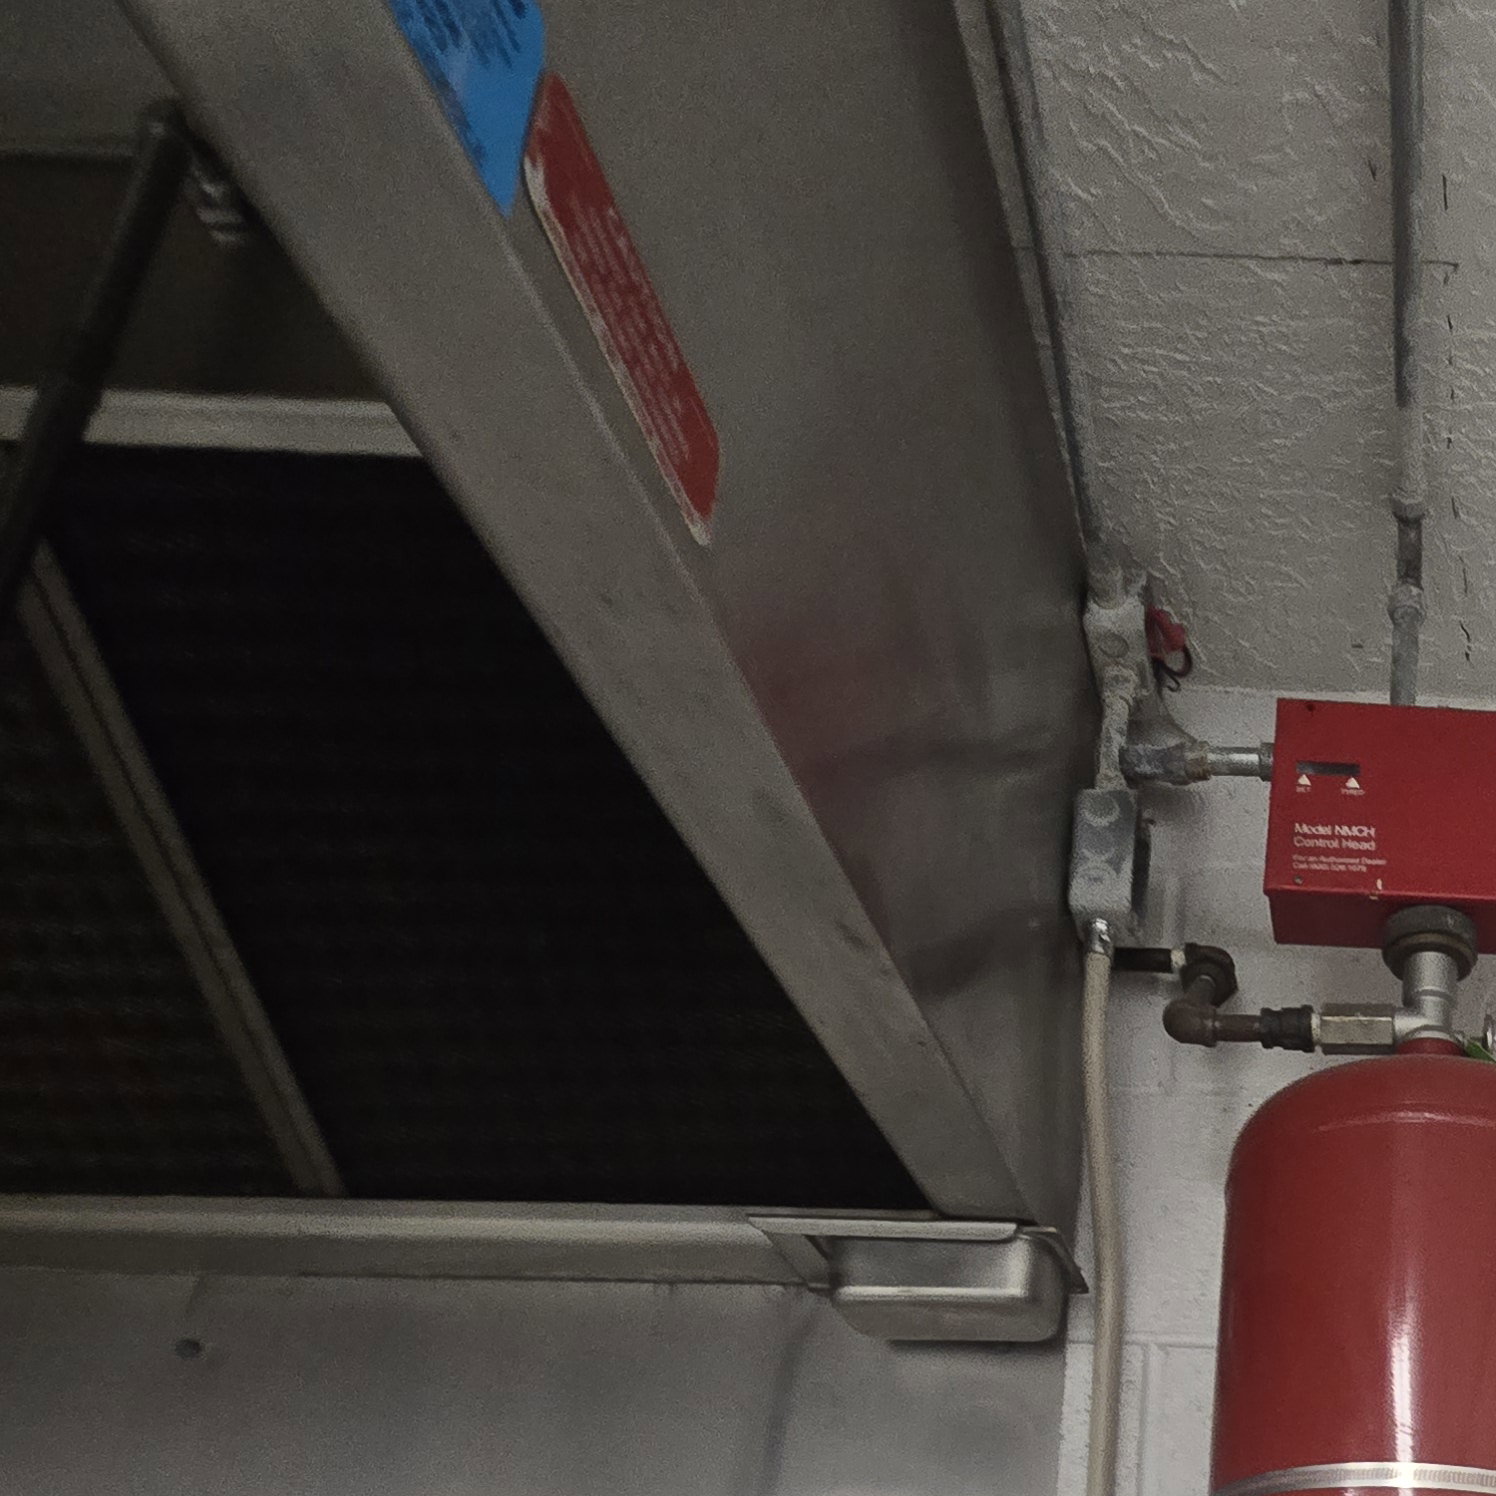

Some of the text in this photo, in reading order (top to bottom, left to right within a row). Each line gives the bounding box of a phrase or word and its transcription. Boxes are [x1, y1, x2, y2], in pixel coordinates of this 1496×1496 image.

[1294, 823, 1332, 835] Model
[1293, 836, 1376, 851] Control Head
